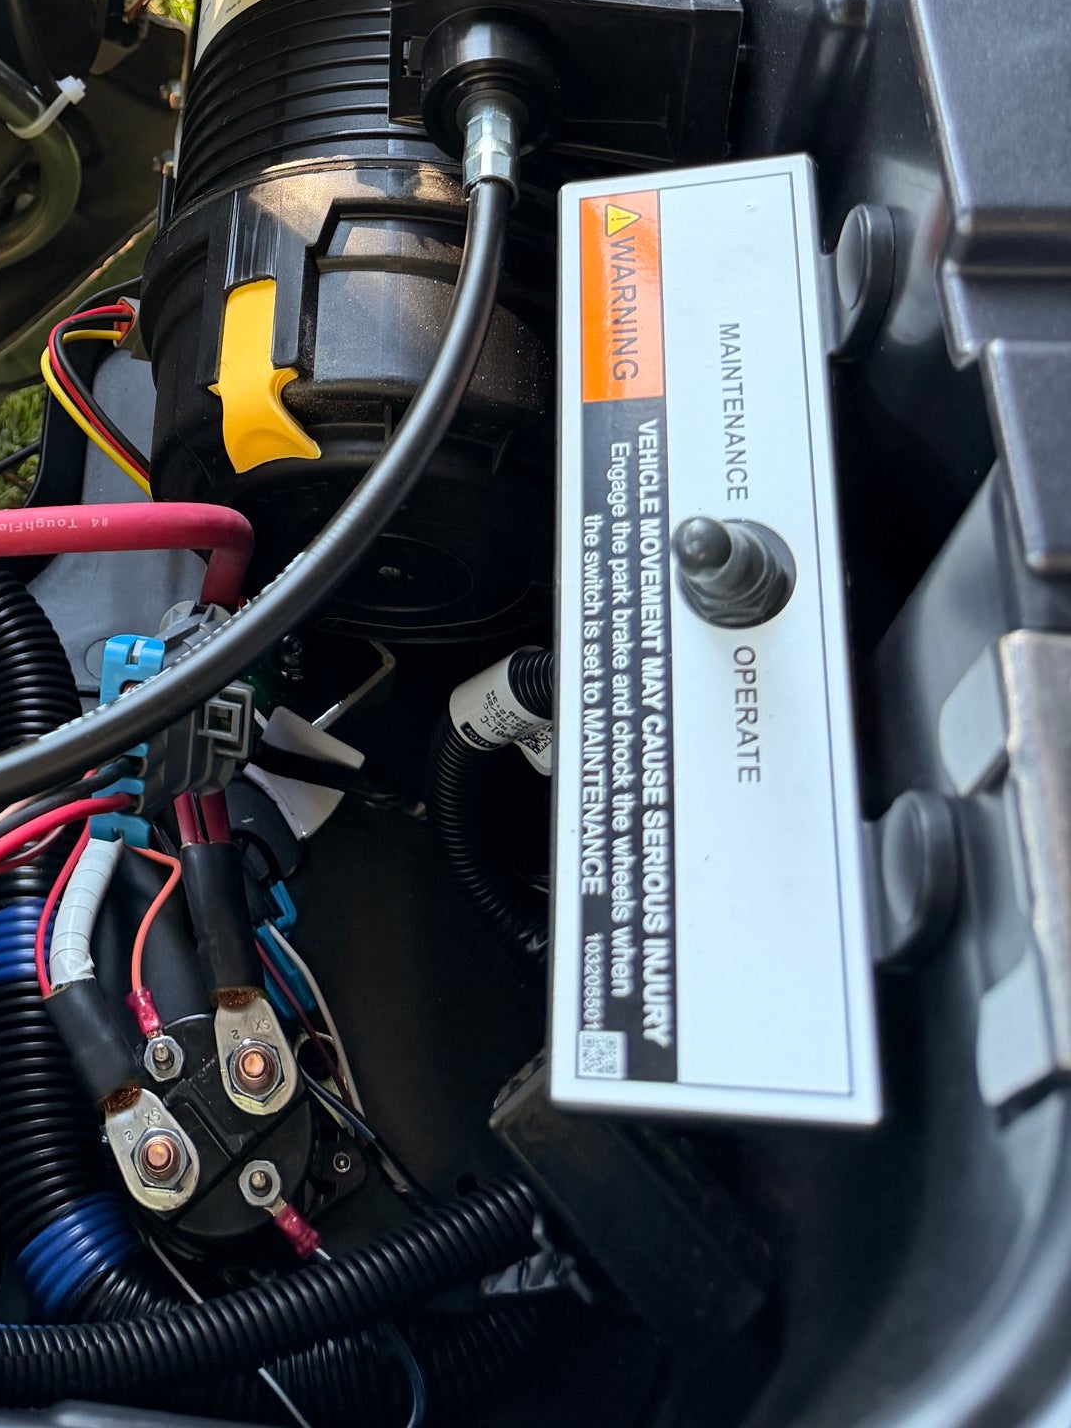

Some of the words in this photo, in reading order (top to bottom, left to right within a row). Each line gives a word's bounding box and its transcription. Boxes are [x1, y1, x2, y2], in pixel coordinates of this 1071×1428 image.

[609, 235, 639, 382] WARNING
[718, 322, 749, 502] MAINTENANCE
[605, 441, 630, 518] Engage
[636, 418, 660, 514] VEHICLE
[582, 513, 602, 548] the
[611, 521, 631, 554] the
[581, 550, 603, 615] switch
[606, 558, 631, 605] park
[637, 517, 663, 652] MOVEMENT
[581, 621, 602, 637] is
[581, 643, 602, 677] set
[610, 608, 633, 670] brake
[582, 681, 602, 703] to
[610, 673, 633, 715] and
[640, 657, 665, 710] MAY
[731, 645, 763, 785] OPERATE
[610, 721, 634, 788] chock
[639, 714, 666, 806] CAUSE
[579, 708, 604, 896] MAINTENANCE
[610, 793, 634, 832] the
[608, 836, 635, 924] wheels
[639, 809, 669, 935] SERIOUS
[582, 931, 603, 1031] 103205501
[609, 925, 635, 997] when
[639, 937, 670, 1048] INJURY
